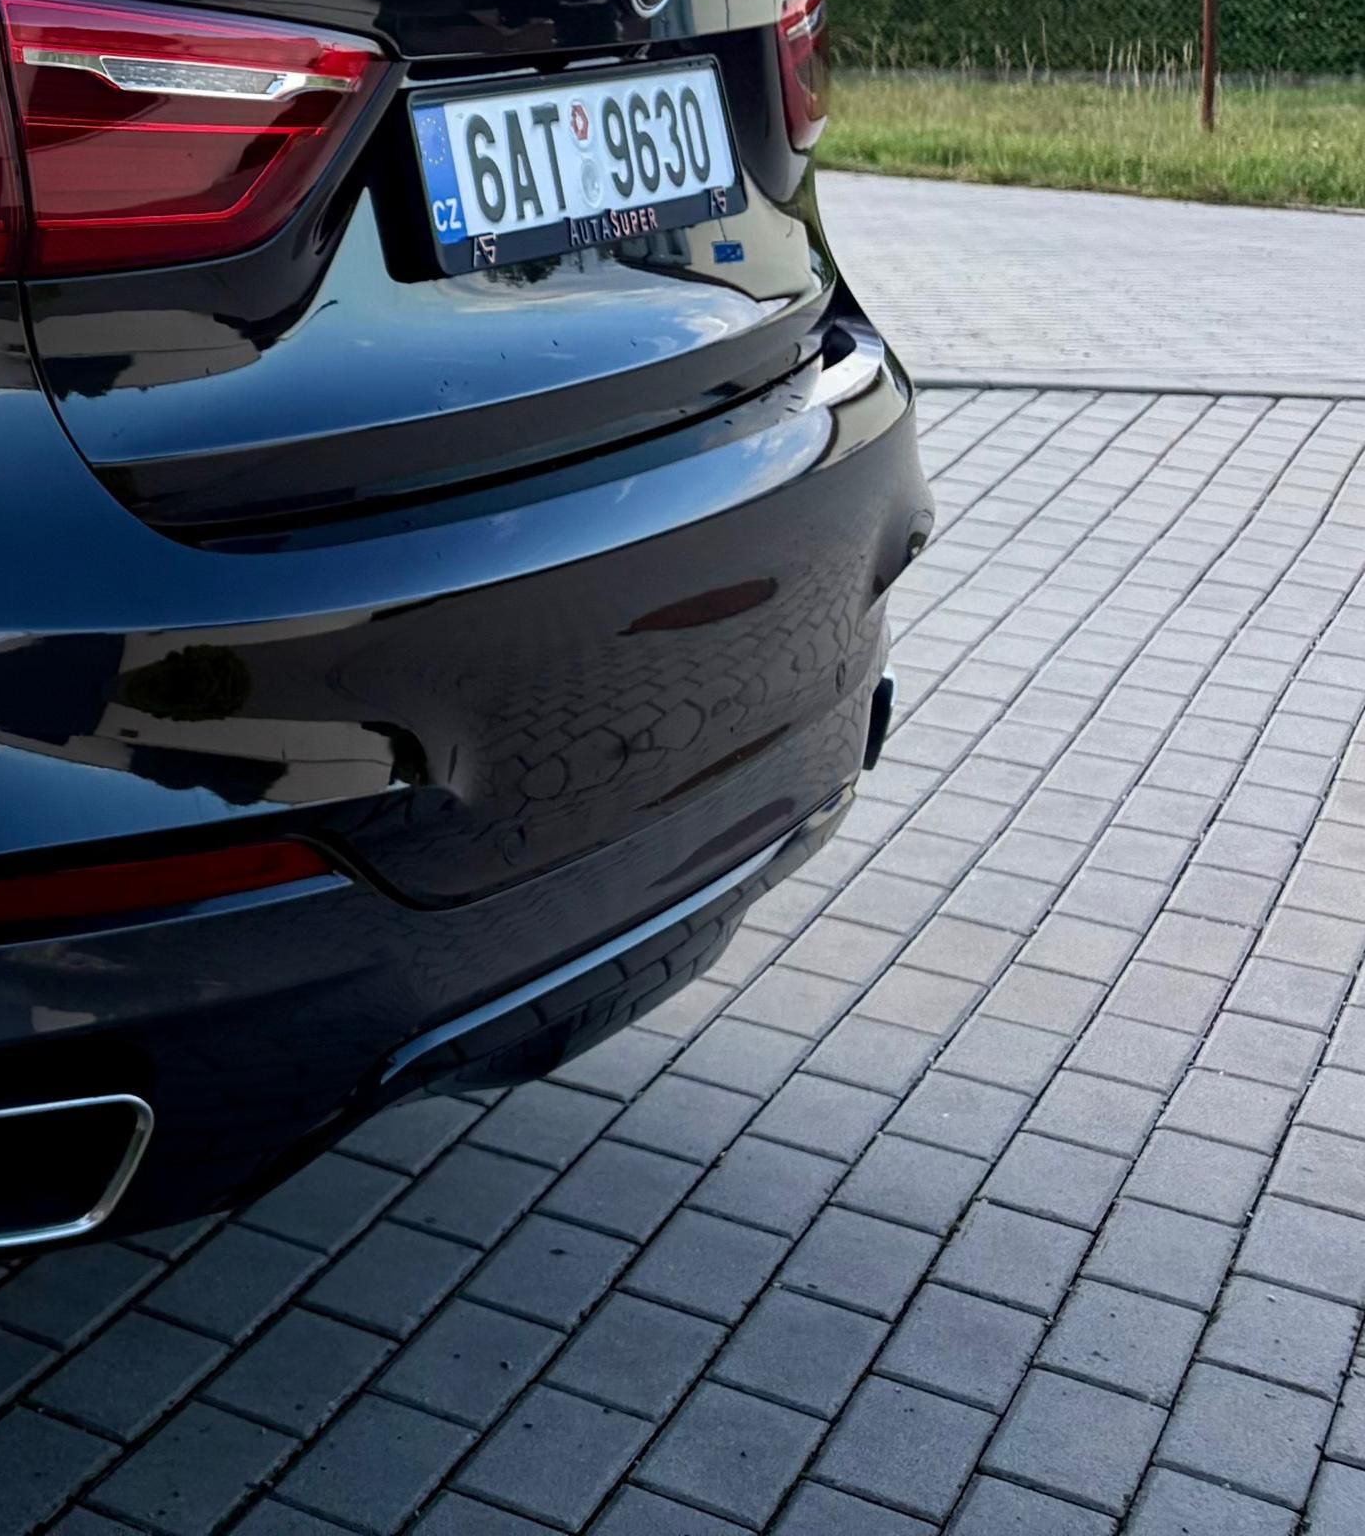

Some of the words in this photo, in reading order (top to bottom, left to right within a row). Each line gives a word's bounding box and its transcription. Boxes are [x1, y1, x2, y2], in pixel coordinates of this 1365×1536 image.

[466, 104, 567, 224] 6AT
[601, 85, 711, 198] 9630
[432, 197, 462, 232] CZ
[569, 207, 658, 246] AUTASUPER
